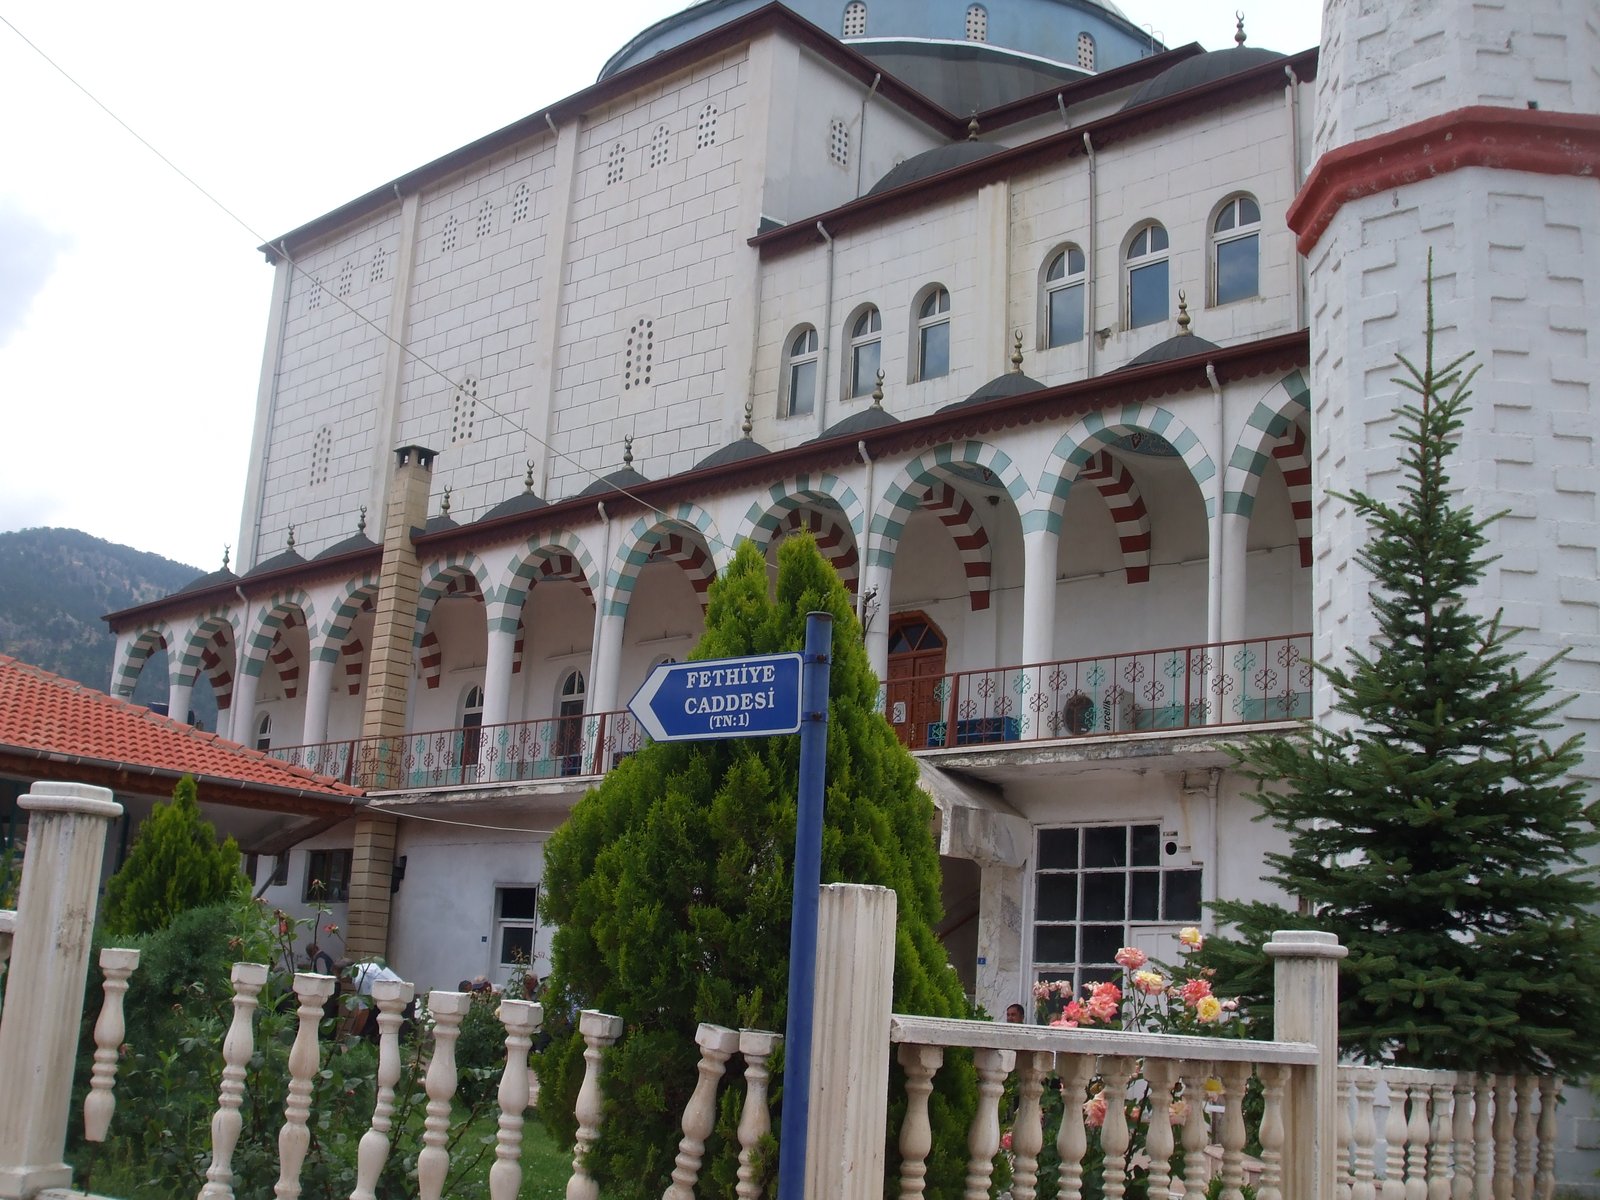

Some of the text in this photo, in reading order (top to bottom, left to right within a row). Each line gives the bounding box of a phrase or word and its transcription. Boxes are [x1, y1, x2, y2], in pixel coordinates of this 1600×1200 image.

[686, 664, 775, 689] FETHİYE
[684, 687, 775, 714] CADDESİ
[709, 712, 750, 730] (TN:1)
